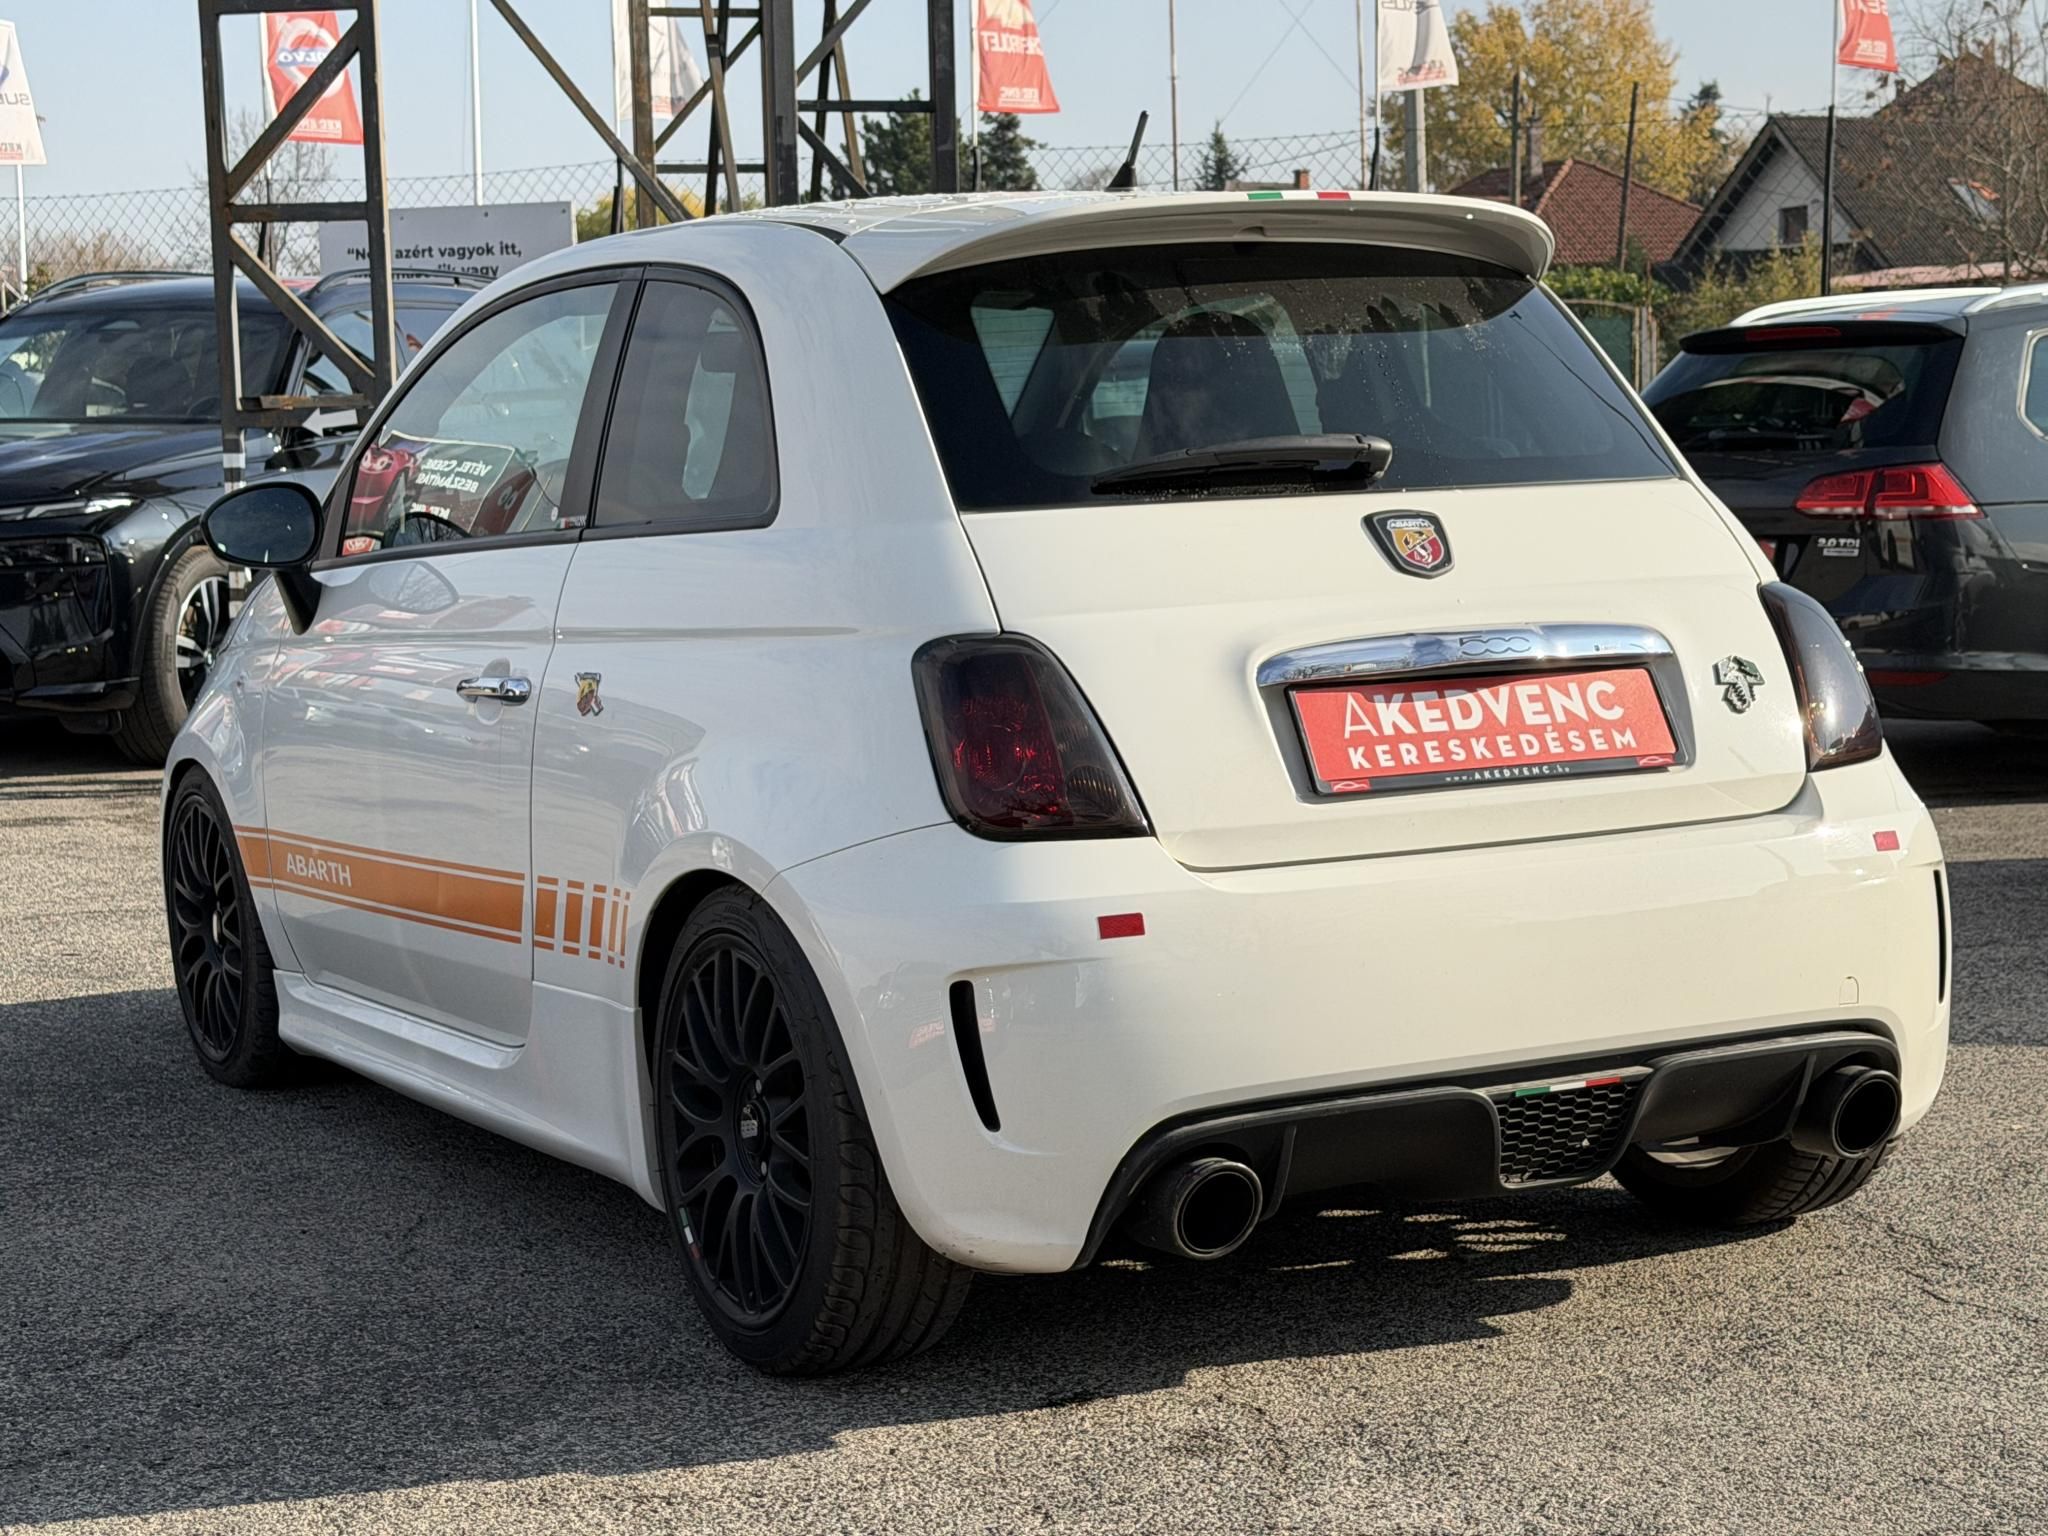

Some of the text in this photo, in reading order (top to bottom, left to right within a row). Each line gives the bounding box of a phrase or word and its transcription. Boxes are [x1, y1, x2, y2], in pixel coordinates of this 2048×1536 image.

[395, 244, 434, 259] azért
[438, 243, 495, 258] vagyok
[499, 241, 522, 257] itt,
[1838, 538, 1861, 548] TDI
[1459, 635, 1532, 656] 500
[1344, 681, 1625, 739] AKEDVENC
[1347, 725, 1638, 770] KERESKEDÉSEM
[286, 852, 353, 888] ABARTH
